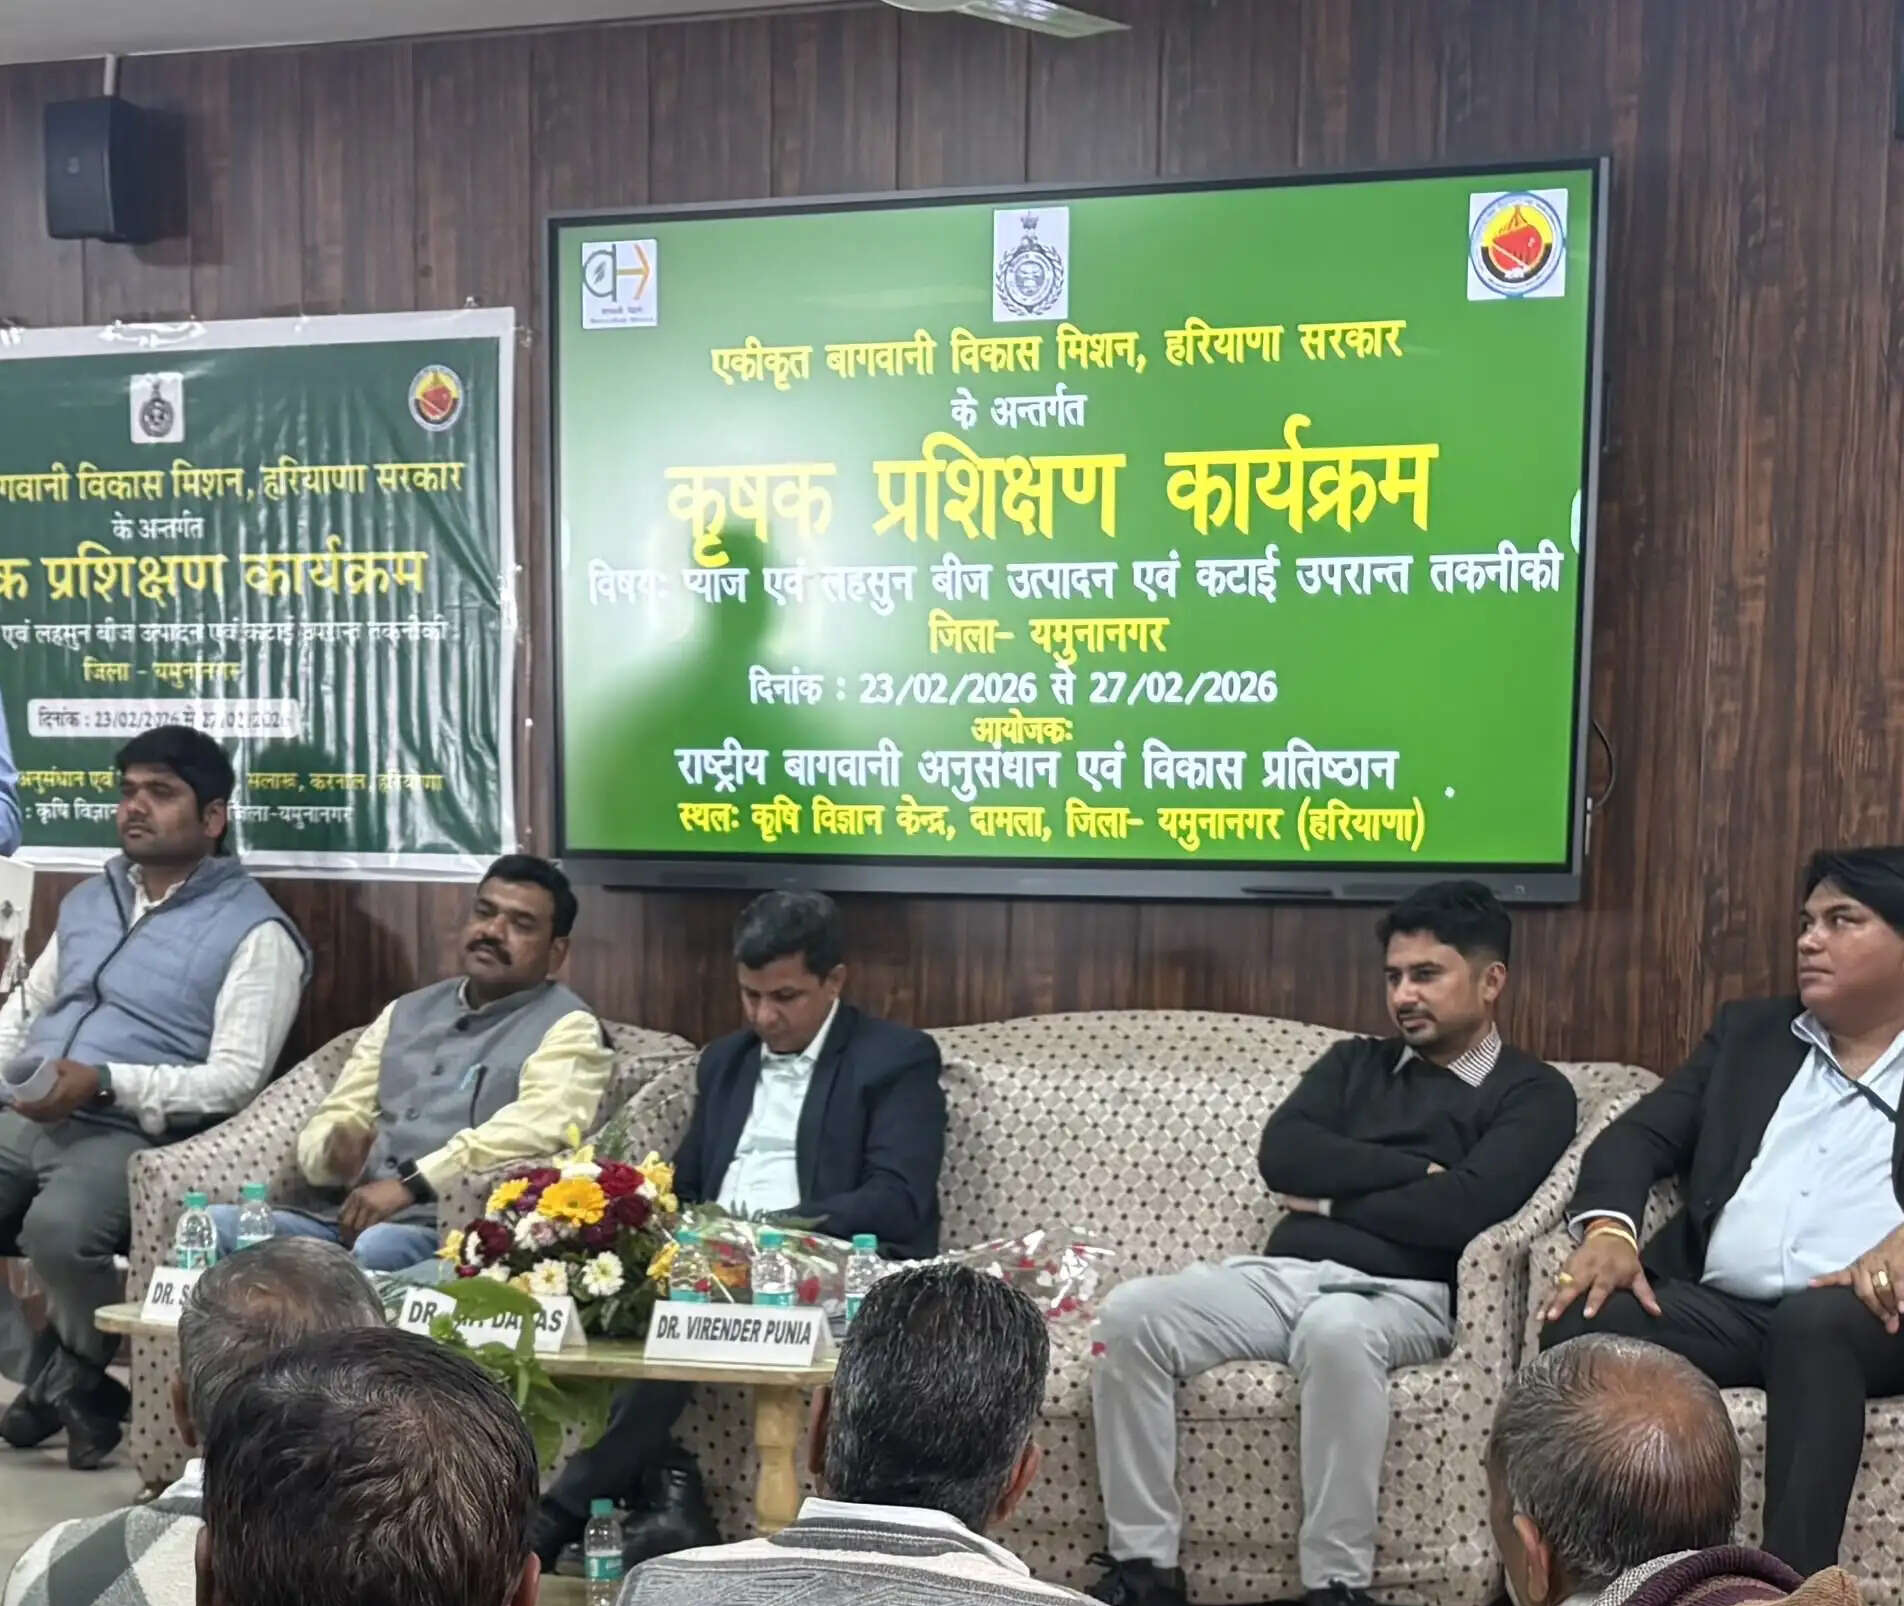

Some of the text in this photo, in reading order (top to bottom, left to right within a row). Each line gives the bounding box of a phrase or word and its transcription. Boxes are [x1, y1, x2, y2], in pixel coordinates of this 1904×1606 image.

[711, 316, 1406, 391] एकीकृत बागवानी विकास मिशन, हरियाणा सरकार
[951, 382, 1087, 430] के अन्तर्गत
[76, 462, 164, 501] विकास
[259, 455, 368, 499] हरियाणा
[373, 462, 465, 493] सरकार
[665, 413, 1439, 567] कृषक प्रशिक्षण कार्यक्रम
[111, 509, 205, 540] के अन्तर्गत
[40, 541, 228, 607] प्रशिक्षण
[240, 534, 428, 595] कार्यक्रम
[682, 567, 750, 604] प्याज
[762, 556, 807, 607] एवं
[820, 566, 916, 616] लहसुन
[930, 552, 993, 601] बीज
[1007, 561, 1118, 601] उत्पादन
[1132, 549, 1180, 602] एवं
[1195, 544, 1280, 603] कटाई
[1296, 555, 1413, 595] उपरान्त
[1430, 539, 1564, 594] तकनीकी
[0, 619, 31, 649] एवं
[34, 624, 93, 651] लहसुन
[95, 617, 137, 643] बीज
[1029, 616, 1170, 665] यमुनानगर
[82, 656, 132, 682] जिला
[749, 665, 823, 704] दिनांक
[859, 672, 1037, 705] 23/02/2026
[1050, 664, 1076, 705] से
[1089, 671, 1278, 705] 27/02/2026
[38, 706, 80, 728] दिनांक
[674, 736, 1399, 802] राष्ट्रीय बागवानी अनुसंधान एवं विकास प्रतिष्ठान
[34, 797, 70, 824] कृषि
[751, 794, 800, 841] कृषि
[812, 795, 884, 836] विज्ञान
[896, 794, 956, 841] केन्द्र,
[1157, 809, 1284, 852] यमुनानगर
[1297, 796, 1426, 852] (हरियाणा)
[152, 1282, 175, 1305] DR.
[491, 1309, 565, 1333] DAAS
[656, 1314, 813, 1346] DR. VIRENDER PUNIA
